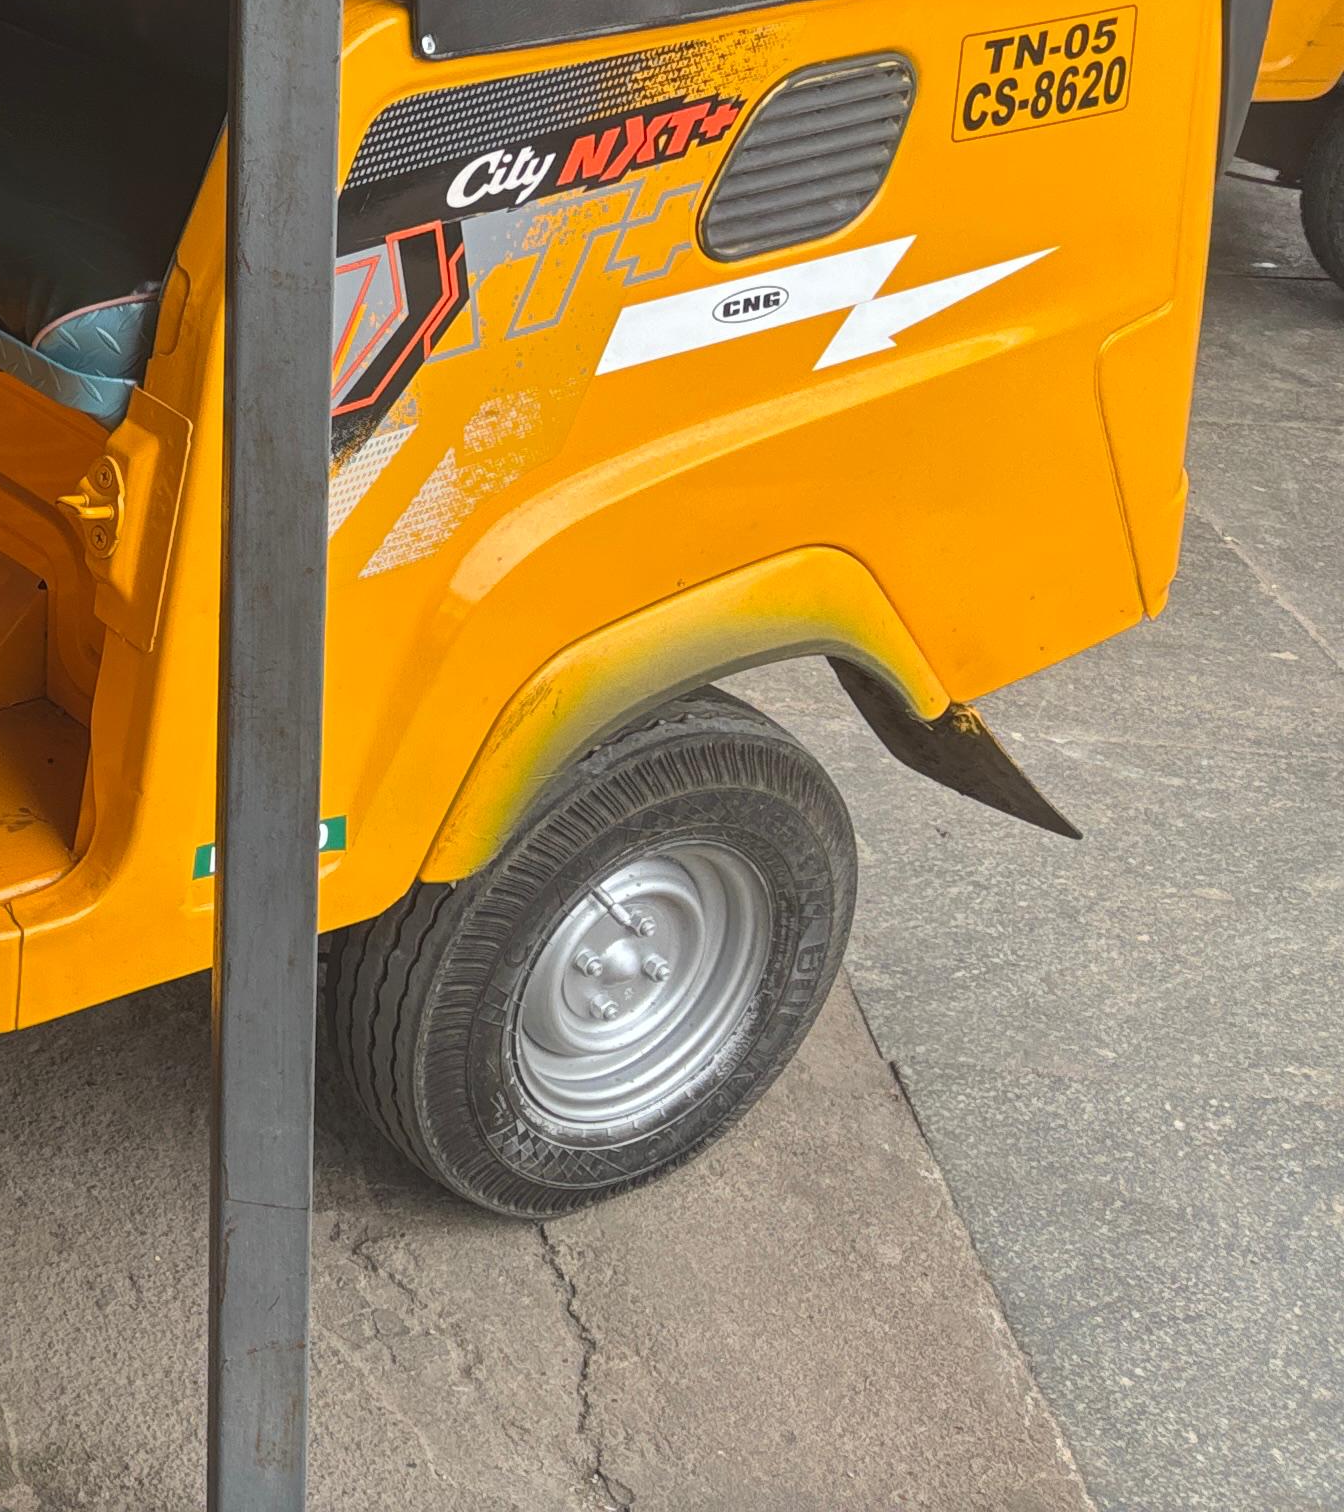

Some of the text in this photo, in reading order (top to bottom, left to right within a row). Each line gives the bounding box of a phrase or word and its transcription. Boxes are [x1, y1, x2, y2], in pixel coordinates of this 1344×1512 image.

[984, 18, 1118, 74] TN-05
[962, 56, 1128, 132] CS-8620
[446, 102, 740, 209] City NXT+
[722, 291, 781, 319] CNG
